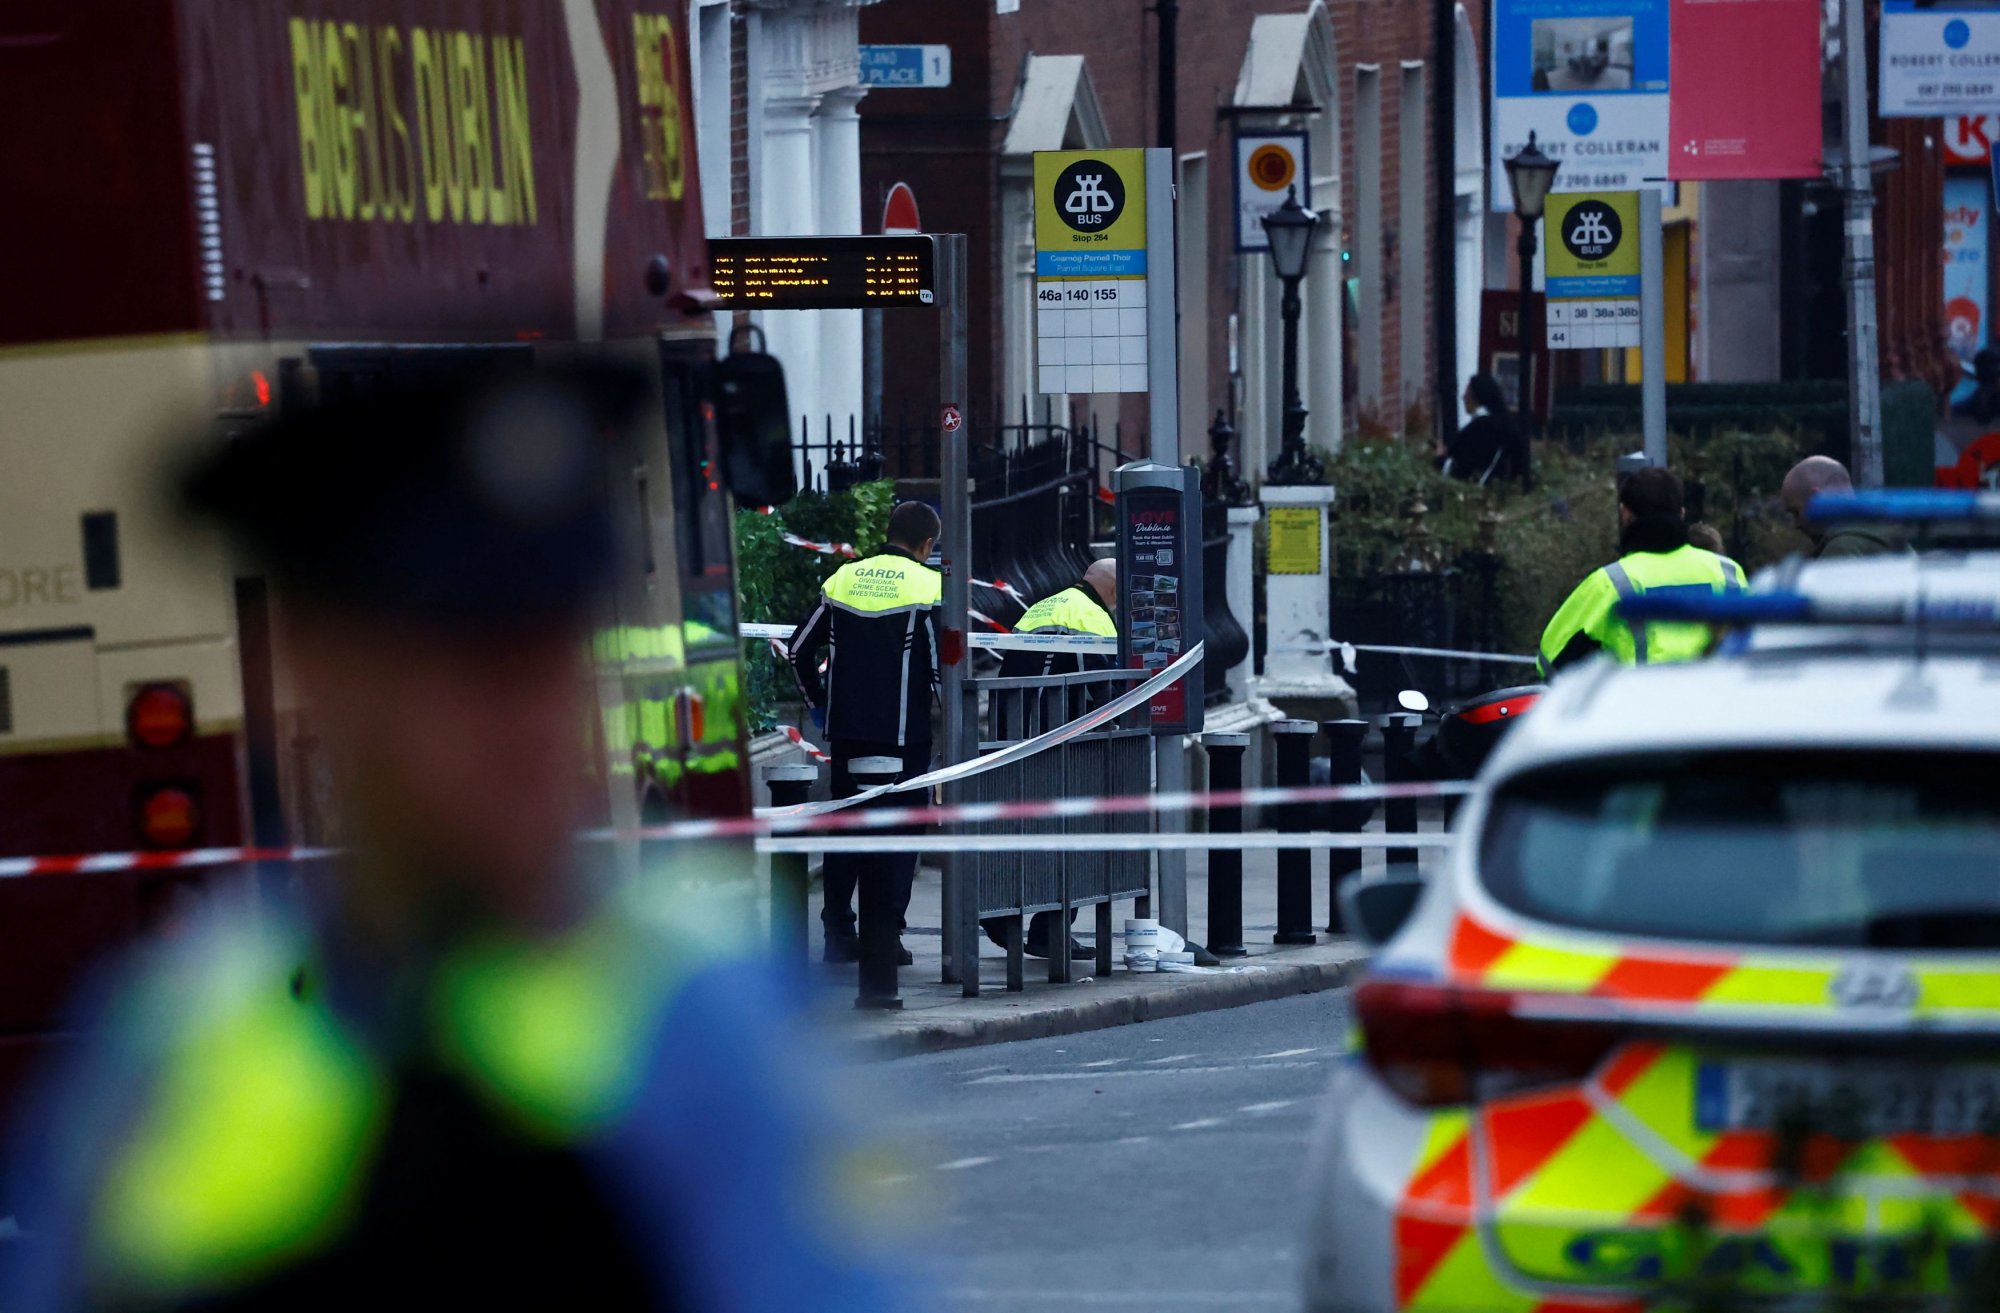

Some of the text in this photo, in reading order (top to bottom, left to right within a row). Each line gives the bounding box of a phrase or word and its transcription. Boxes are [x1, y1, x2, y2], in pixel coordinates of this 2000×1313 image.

[932, 56, 941, 76] 1
[869, 68, 918, 83] PLACE
[411, 26, 537, 226] DUBLIN
[1574, 140, 1659, 155] COLLERAN
[1077, 214, 1102, 224] BUS
[1581, 246, 1602, 254] BUS
[1039, 289, 1116, 301] 46a 140 155
[1555, 307, 1638, 318] 1 38 38a 38b
[1551, 333, 1565, 342] 44
[854, 568, 905, 580] GARDA
[858, 577, 896, 586] DIVISIONAL
[852, 583, 899, 592] CRIME SCENE
[848, 590, 900, 599] INVESTIGATION
